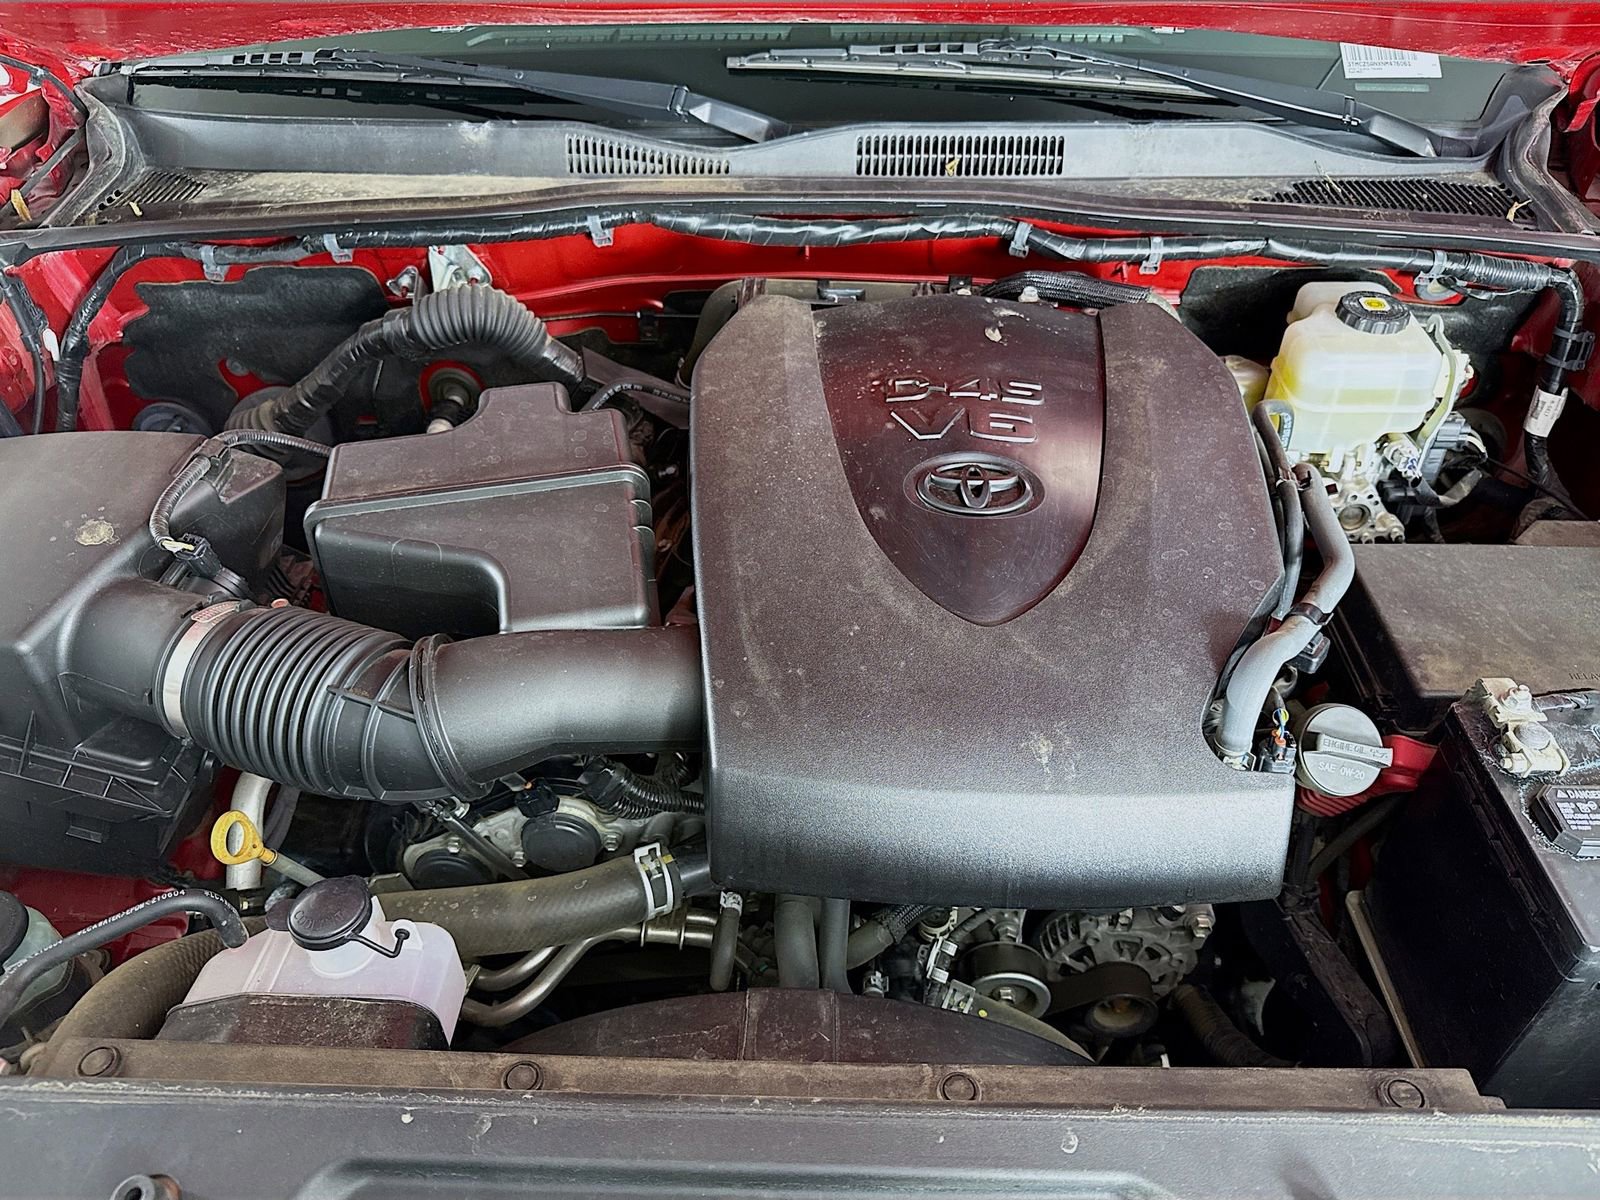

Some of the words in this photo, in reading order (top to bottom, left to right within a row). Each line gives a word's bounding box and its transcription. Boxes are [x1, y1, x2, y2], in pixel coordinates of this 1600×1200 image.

[889, 406, 1039, 444] V6
[1322, 738, 1353, 754] ENGINE
[1353, 744, 1367, 755] OIL
[1319, 761, 1337, 773] SAE
[1340, 766, 1366, 780] 0W-20
